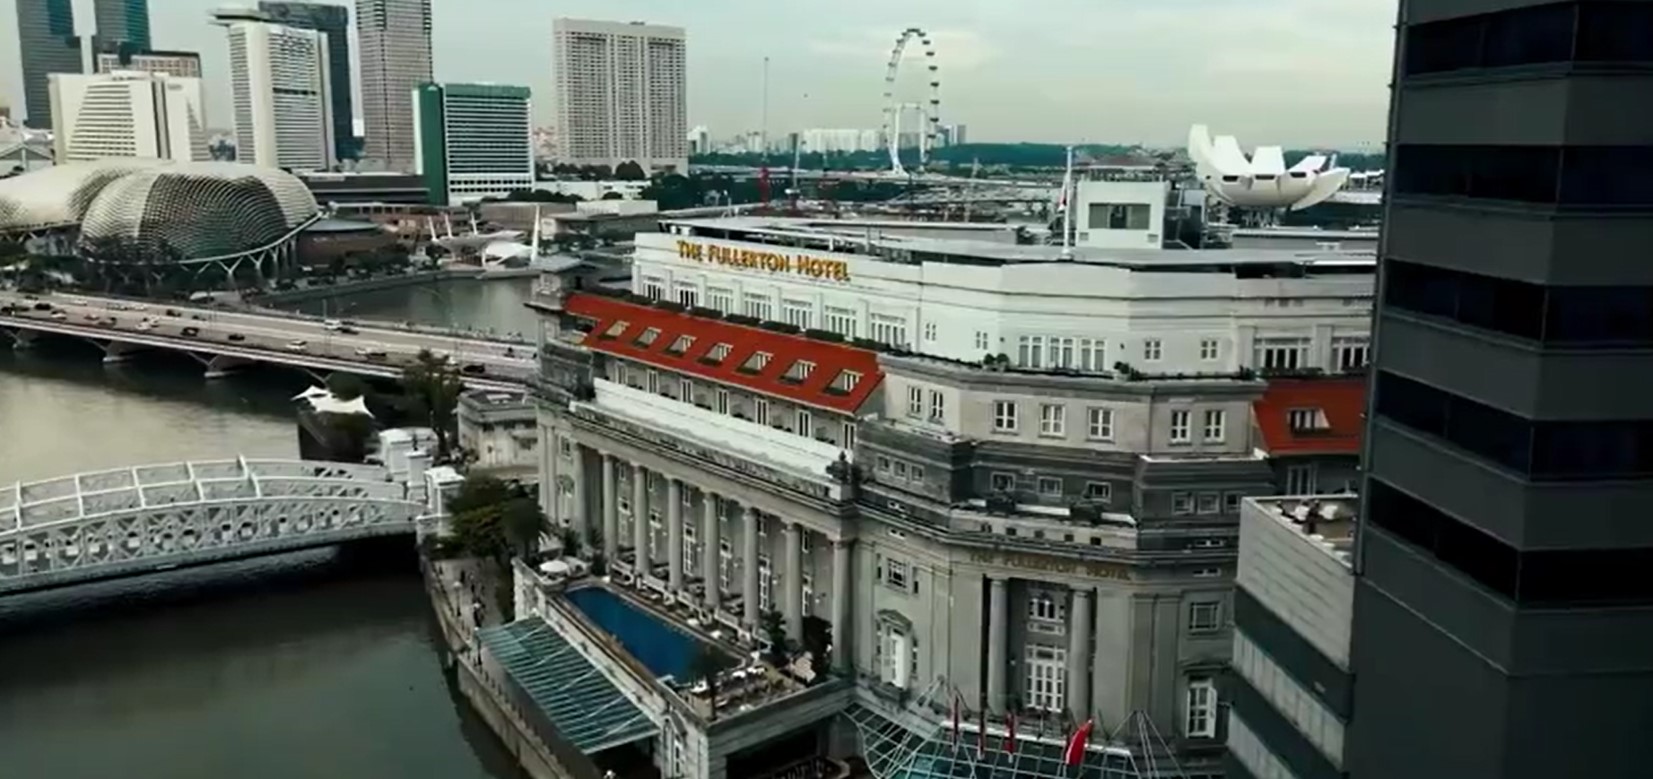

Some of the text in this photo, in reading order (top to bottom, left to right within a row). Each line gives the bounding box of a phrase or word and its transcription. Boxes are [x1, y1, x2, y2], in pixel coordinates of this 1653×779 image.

[677, 240, 851, 282] THE FULLERTON HOTEL
